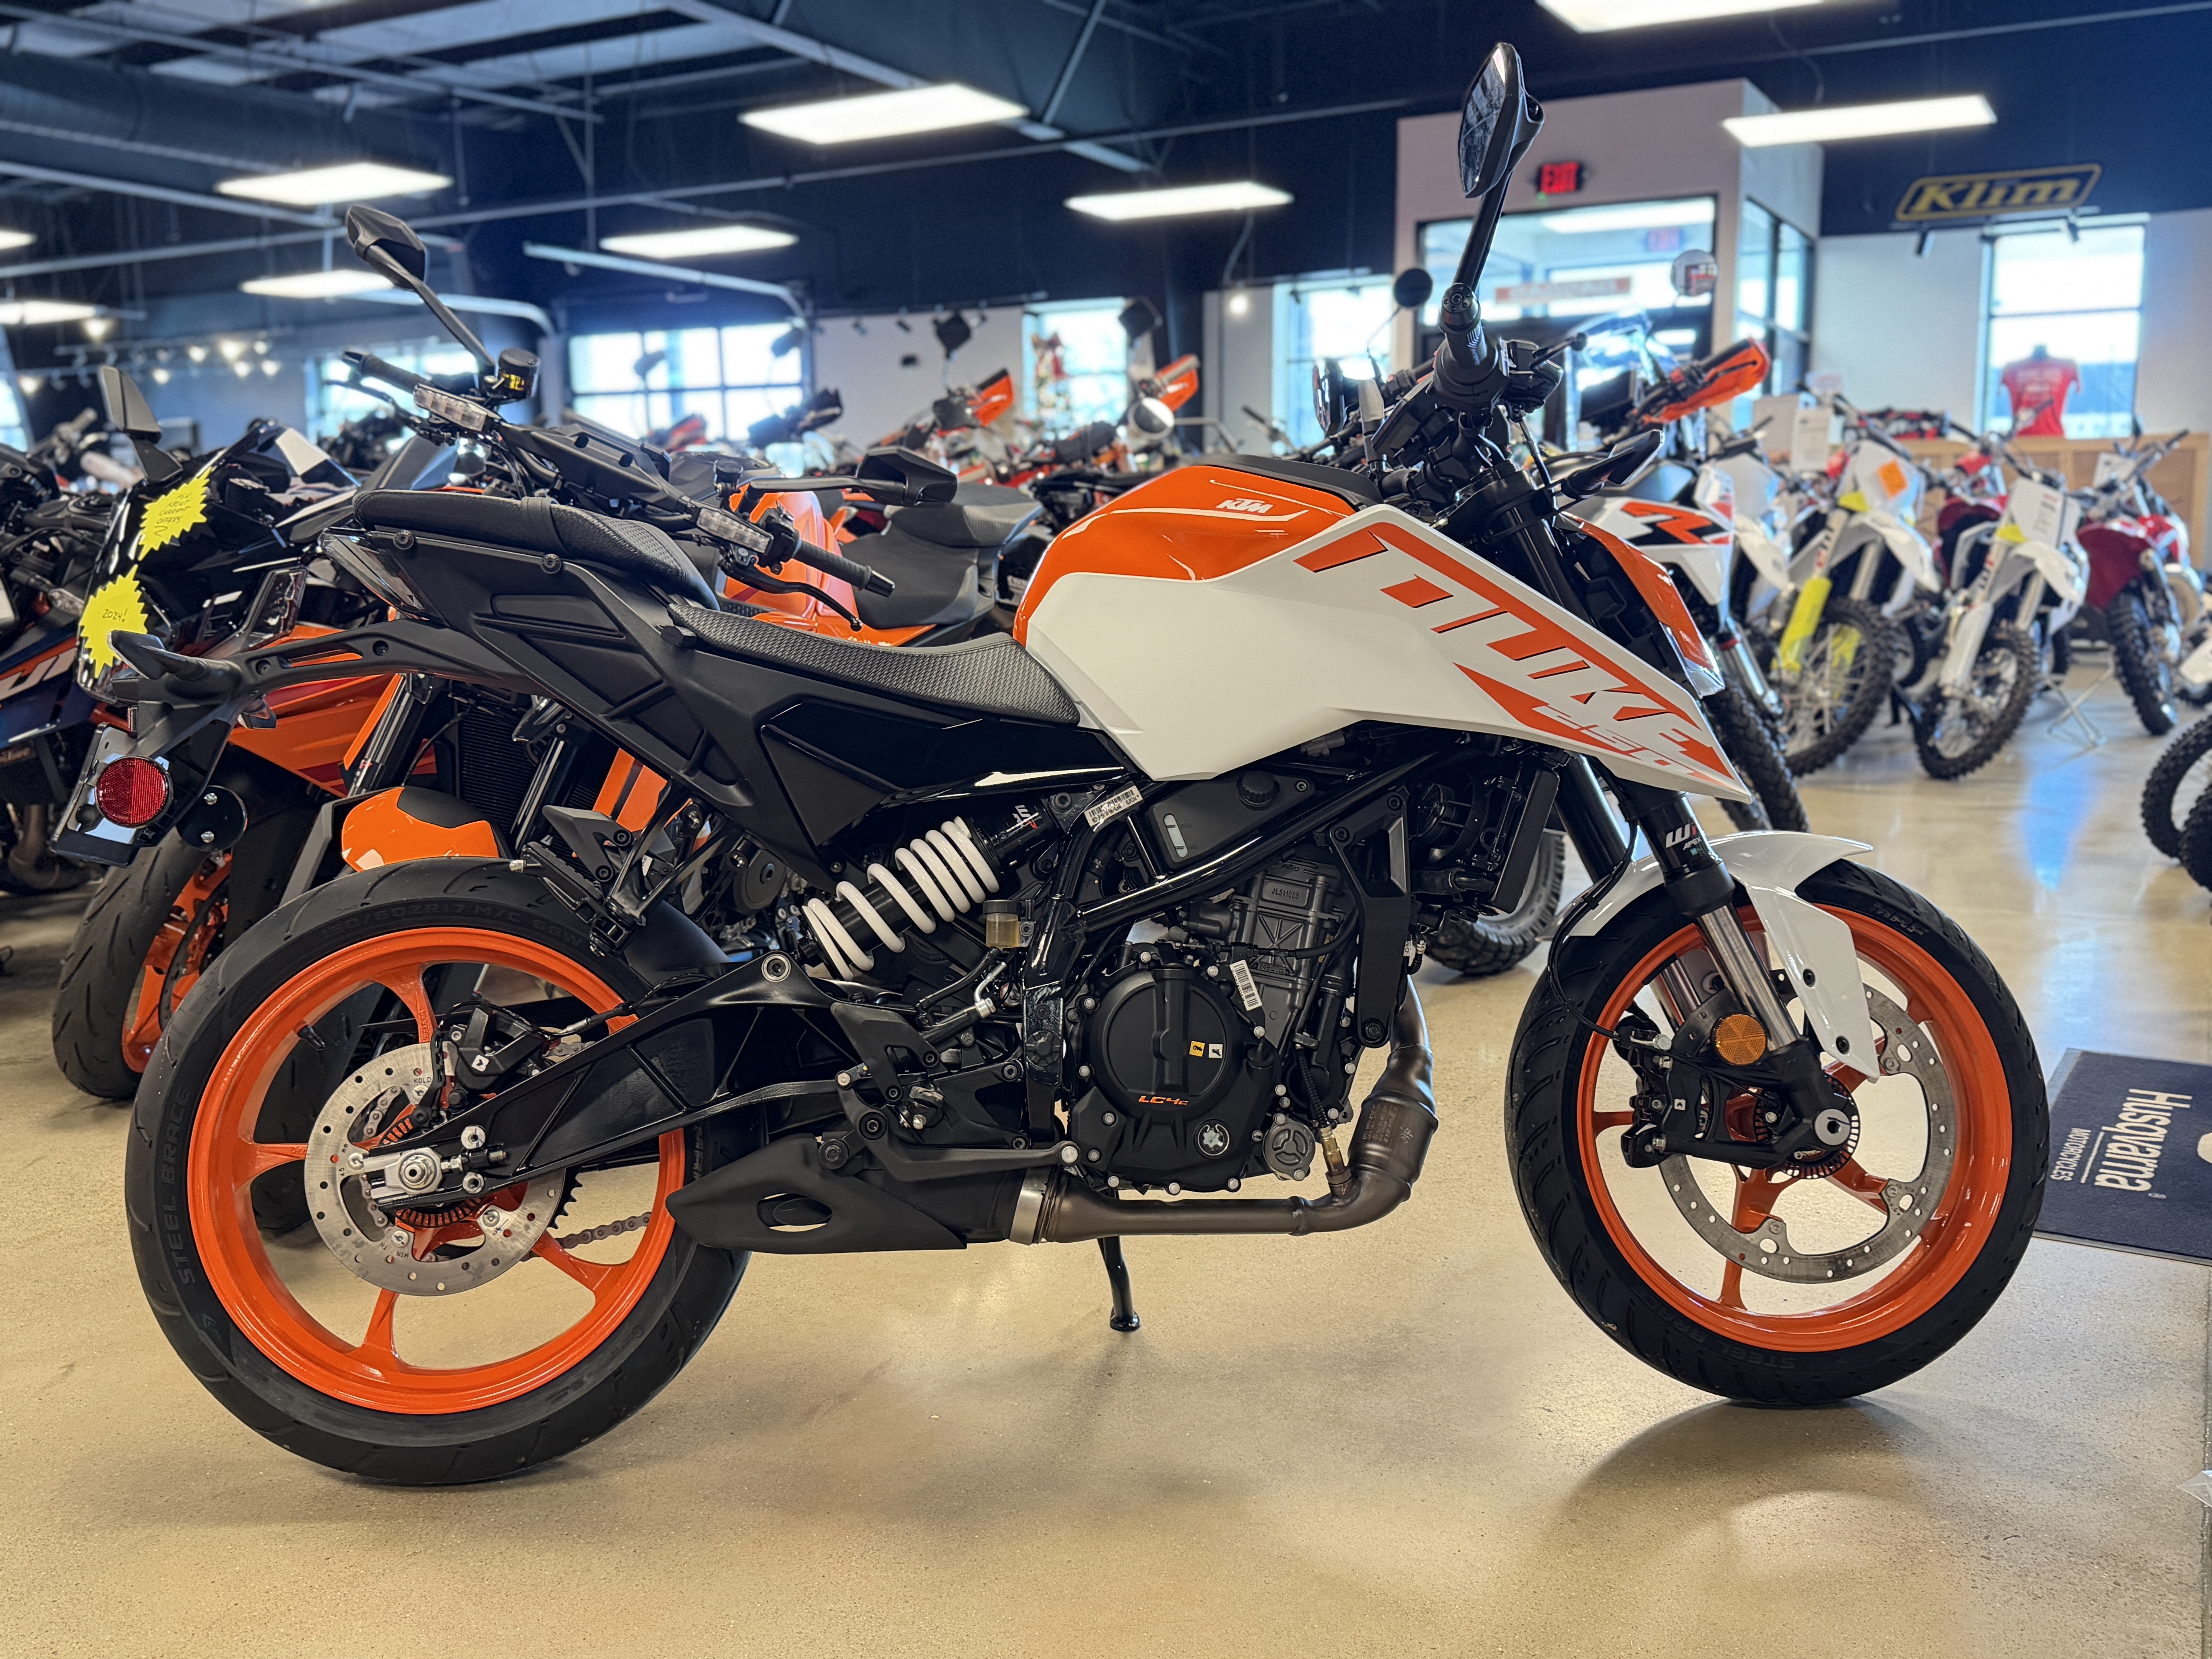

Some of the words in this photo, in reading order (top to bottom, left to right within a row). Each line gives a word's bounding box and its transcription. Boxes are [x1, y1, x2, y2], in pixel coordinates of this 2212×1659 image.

[1216, 498, 1274, 514] KTM
[102, 608, 128, 622] 2024!
[1303, 527, 1725, 769] DUKE
[1682, 836, 1702, 851] APEX
[162, 1085, 190, 1185] BRACE
[2050, 1127, 2092, 1182] MOTORCYCLES
[2094, 1089, 2193, 1192] Husqvarna
[162, 1190, 196, 1286] STEEL
